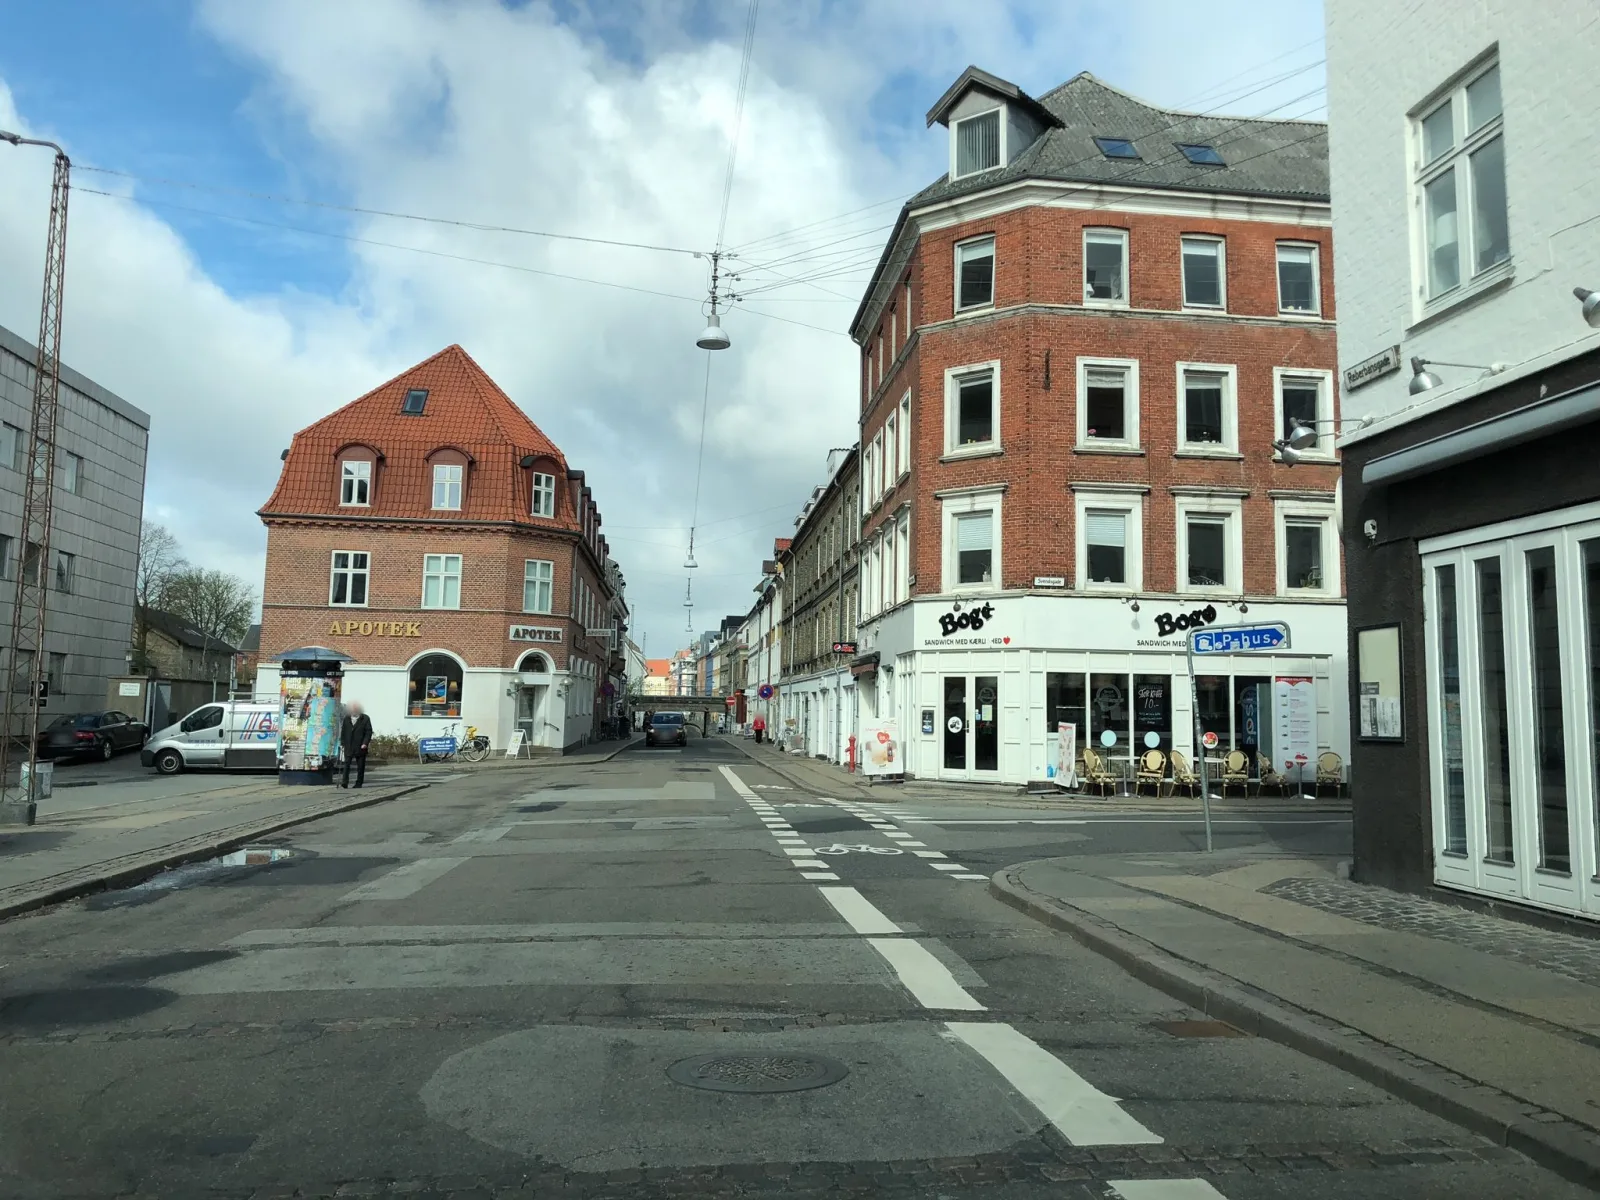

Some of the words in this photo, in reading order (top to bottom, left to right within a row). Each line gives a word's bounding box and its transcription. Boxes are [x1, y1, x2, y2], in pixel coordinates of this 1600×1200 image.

[1347, 354, 1391, 384] Reberbansgade
[328, 620, 422, 638] APOTEK
[513, 627, 561, 641] APOTEK
[1136, 639, 1170, 647] SANDWICH
